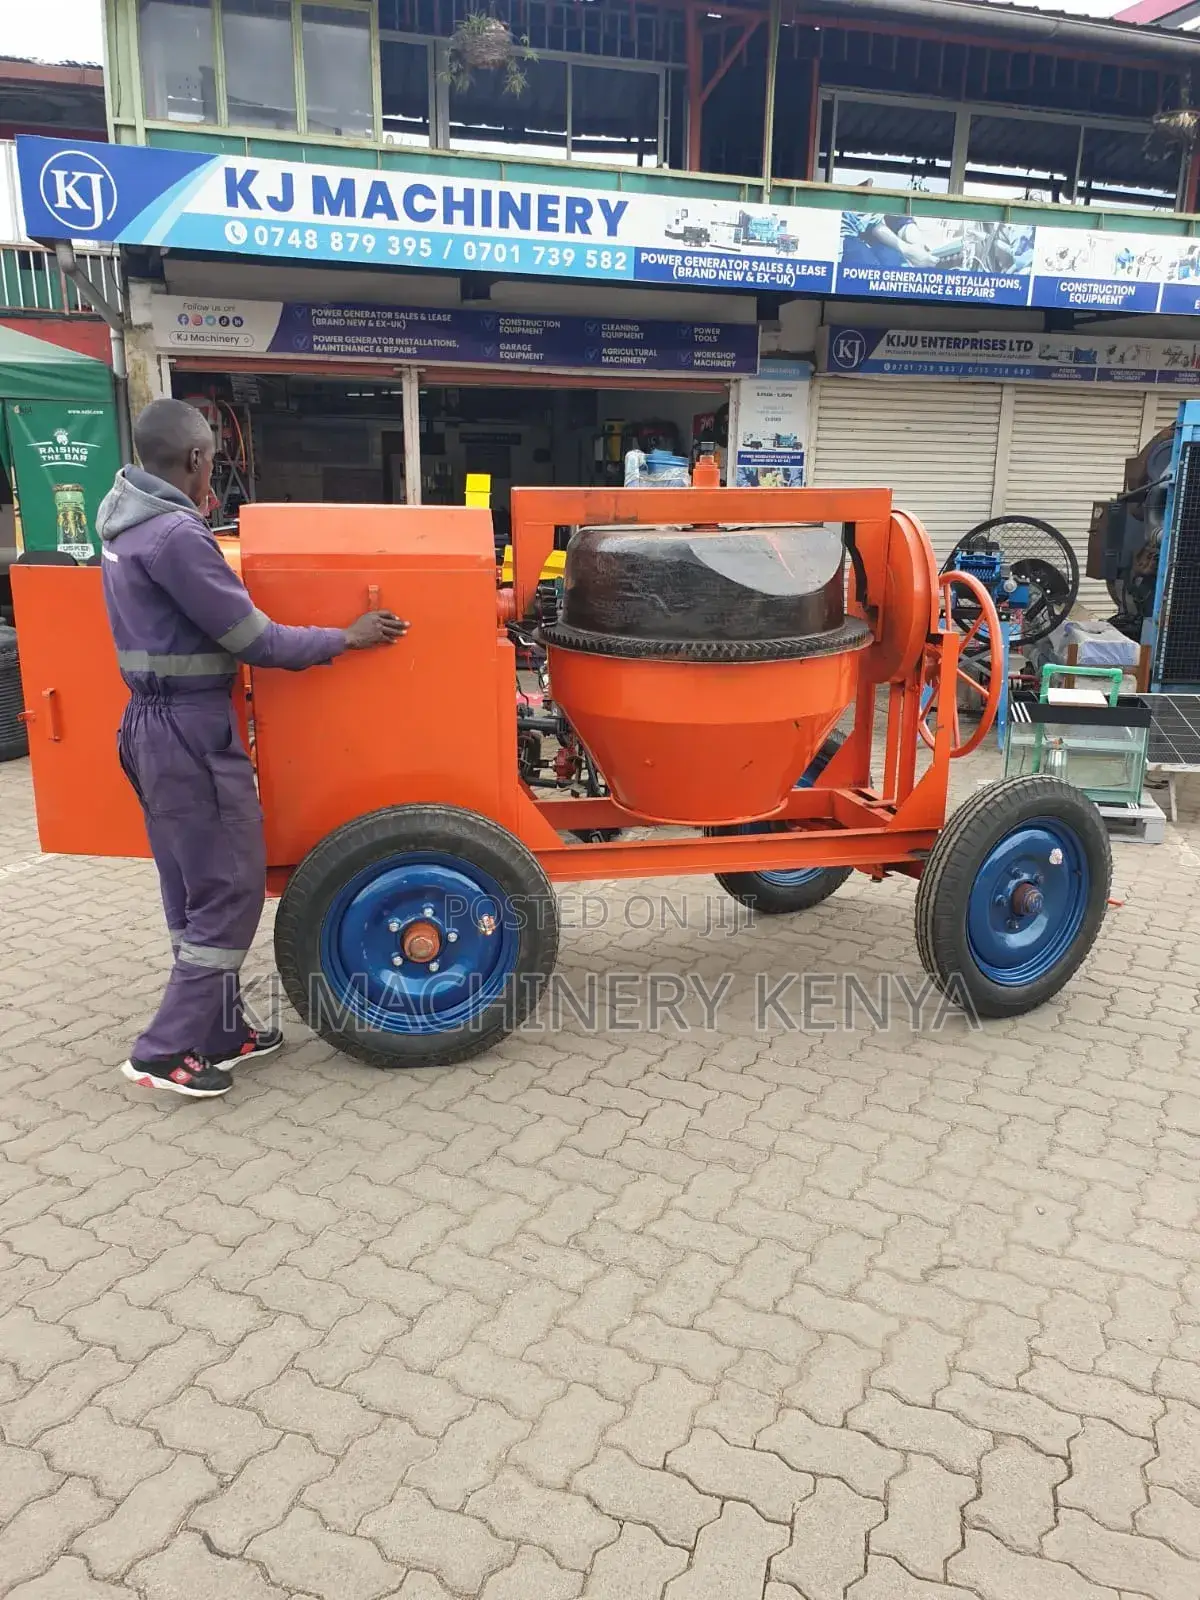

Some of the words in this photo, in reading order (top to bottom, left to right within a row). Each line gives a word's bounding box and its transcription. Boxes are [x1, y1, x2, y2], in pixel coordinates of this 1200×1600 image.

[49, 167, 105, 227] KJ
[224, 166, 296, 213] KJ
[312, 175, 629, 237] MACHINERY
[254, 224, 318, 249] 0748
[329, 228, 376, 254] 879
[386, 232, 432, 258] 395
[443, 239, 454, 260] /
[464, 239, 522, 264] 0701
[532, 243, 575, 266] 739
[585, 247, 628, 271] 582
[640, 252, 681, 266] POWER
[682, 254, 750, 271] GENERATOR
[751, 258, 786, 273] SALES
[786, 261, 795, 273] &
[796, 262, 828, 278] LEASE
[672, 263, 713, 281] (BRAND
[715, 267, 745, 281] NEW
[746, 269, 755, 283] &
[755, 269, 796, 288] EX-UK)
[842, 267, 881, 282] POWER
[882, 270, 943, 286] GENERATOR
[944, 274, 1023, 291] INSTALLATIONS,
[869, 279, 944, 295] MAINTENANCE
[945, 283, 953, 296] &
[954, 283, 996, 299] REPAIRS
[1059, 281, 1136, 296] CONSTRUCTION
[1069, 291, 1124, 305] EQUIPMENT
[312, 308, 342, 318] POWER
[343, 309, 392, 320] GENERATOR
[394, 312, 418, 321] SALES
[419, 313, 426, 321] &
[427, 313, 452, 322] LEASE
[312, 317, 344, 328] (BRAND
[346, 319, 366, 328] NEW
[367, 320, 374, 328] &
[375, 320, 406, 330] EX-UK)
[499, 318, 561, 329] CONSTRUCTION
[601, 323, 640, 333] CLEANING
[499, 326, 544, 336] EQUIPMENT
[601, 331, 645, 340] EQUIPMENT
[694, 327, 721, 336] POWER
[176, 332, 188, 342] KJ
[190, 333, 240, 345] Machinery
[312, 335, 342, 345] POWER
[343, 336, 394, 347] GENERATOR
[395, 337, 460, 349] INSTALLATIONS,
[694, 334, 718, 343] TOOLS
[886, 334, 919, 347] KIJU
[922, 336, 1007, 351] ENTERPRISES
[1008, 340, 1034, 352] LTD
[313, 344, 375, 353] MAINTENANCE
[375, 346, 382, 354] &
[383, 346, 418, 355] REPAIRS
[500, 343, 533, 352] GARAGE
[602, 348, 658, 358] AGRICULTURAL
[838, 340, 862, 367] KJ
[500, 351, 544, 361] EQUIPMENT
[602, 355, 648, 365] MACHINERY
[694, 351, 736, 360] WORKSHOP
[694, 359, 737, 368] MACHINERY
[38, 446, 89, 454] RAISING
[64, 453, 88, 462] BAR
